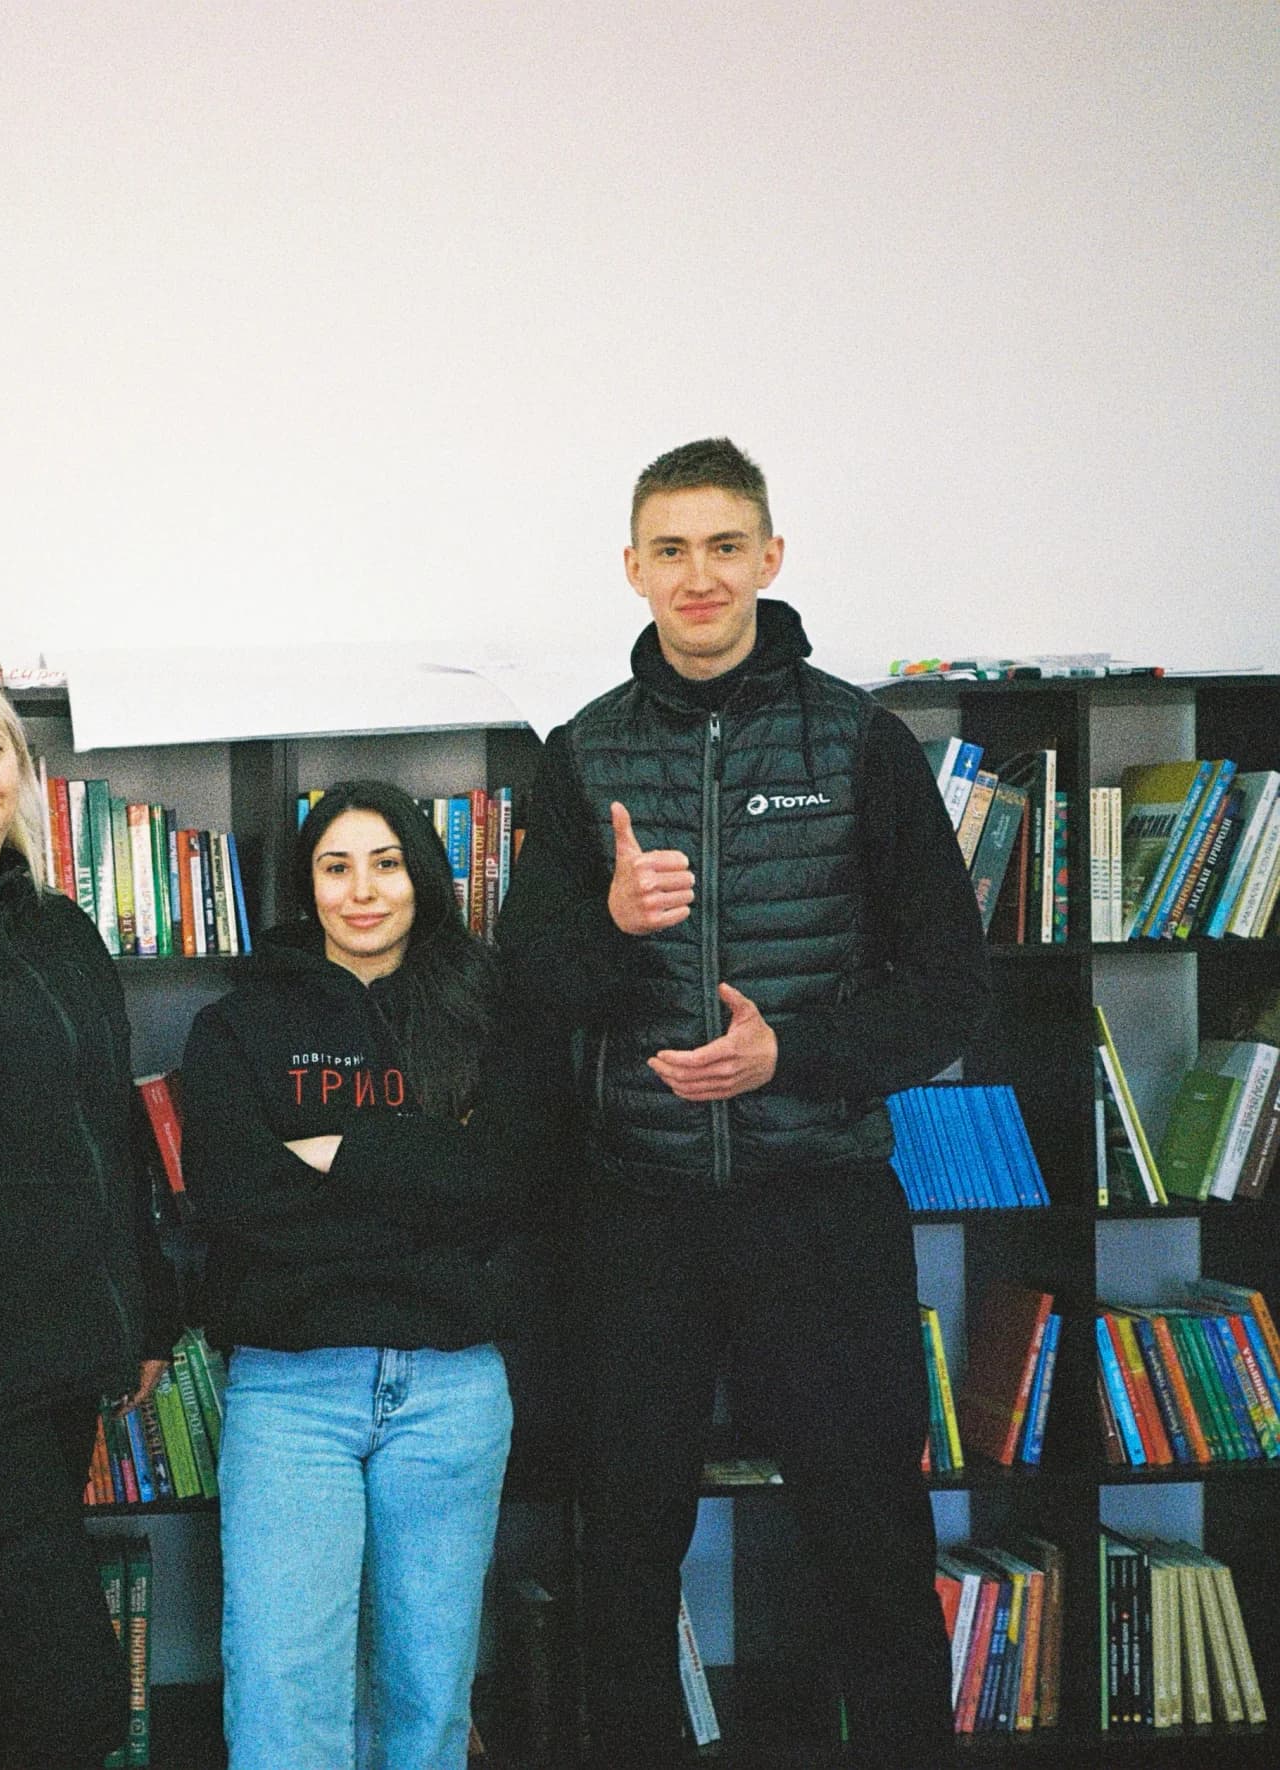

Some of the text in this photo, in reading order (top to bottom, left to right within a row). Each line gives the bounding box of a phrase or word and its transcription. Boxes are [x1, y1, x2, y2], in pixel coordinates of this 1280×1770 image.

[770, 793, 831, 808] TOTAL
[1188, 867, 1212, 911] ЗАГАДКИ
[1207, 817, 1233, 865] ПРИРОДИ
[474, 870, 483, 920] ЗАГАДКИ
[288, 1069, 405, 1108] ТРИО
[1240, 1346, 1272, 1410] КРИНИЧКА
